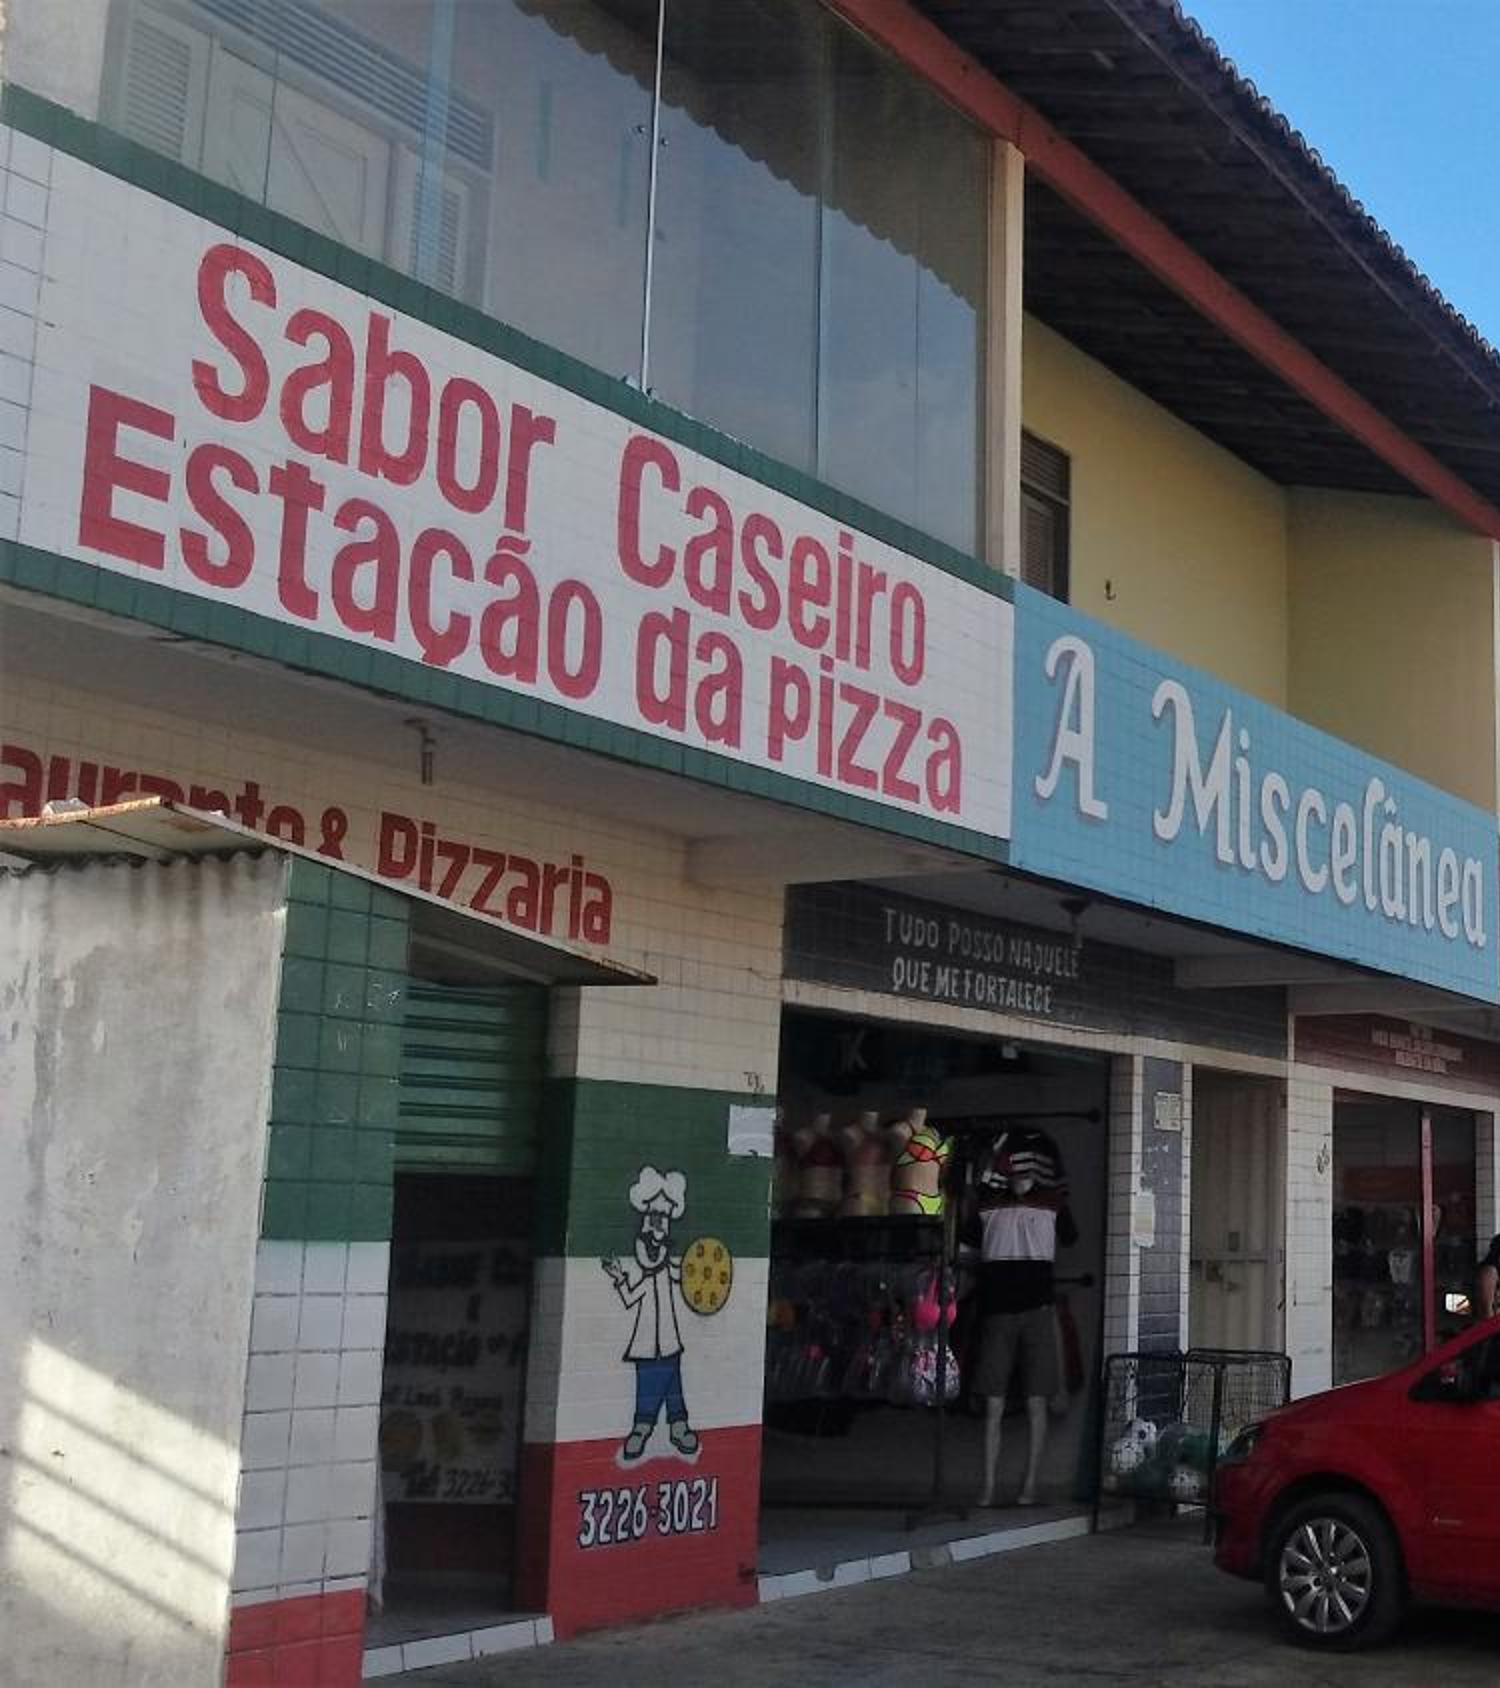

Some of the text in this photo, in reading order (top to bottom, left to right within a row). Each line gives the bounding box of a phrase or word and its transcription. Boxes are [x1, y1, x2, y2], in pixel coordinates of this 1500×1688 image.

[78, 384, 962, 815] Estação da pizza
[191, 243, 926, 687] Sabor Caseiro
[881, 907, 1080, 979] TUDO POSSO NAQUELE
[1035, 635, 1488, 948] A Miscelânea
[892, 956, 1053, 1014] QUE ME FORTALECE
